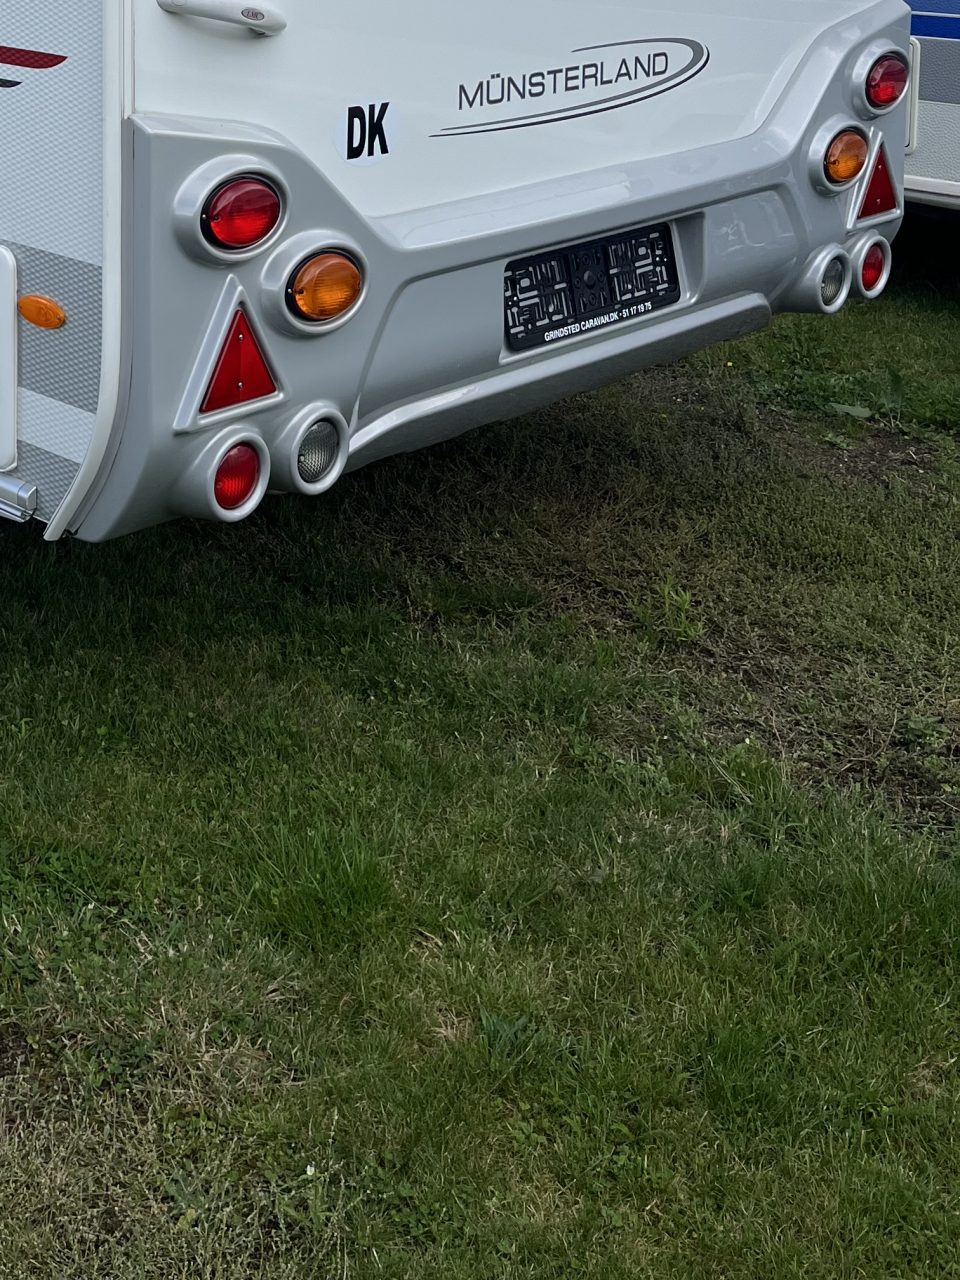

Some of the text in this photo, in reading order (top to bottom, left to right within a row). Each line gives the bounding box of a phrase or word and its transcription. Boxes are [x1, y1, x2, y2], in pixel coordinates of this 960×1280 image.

[457, 51, 669, 111] MÜNSTERLAND
[346, 102, 390, 160] DK
[544, 301, 652, 341] GRINDSTED CARAVAN.DK 51 17 19 75
